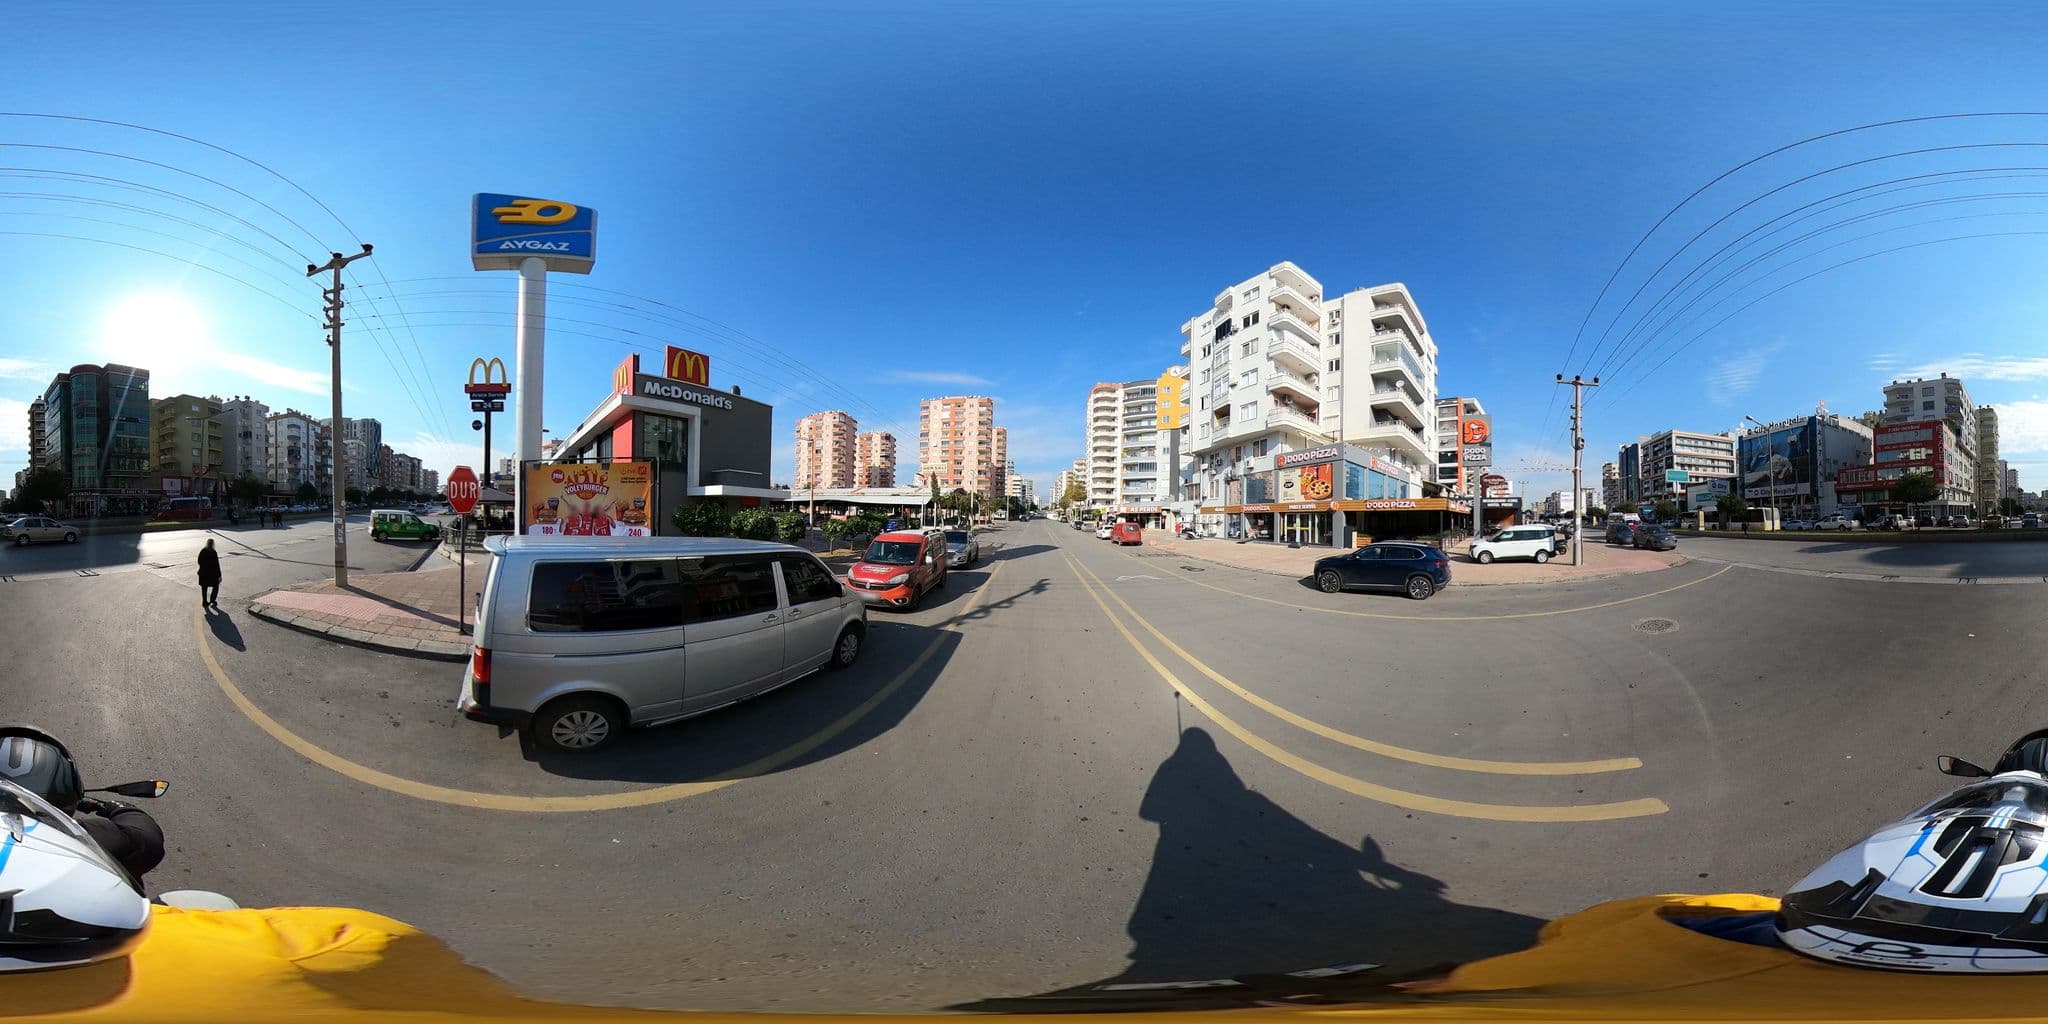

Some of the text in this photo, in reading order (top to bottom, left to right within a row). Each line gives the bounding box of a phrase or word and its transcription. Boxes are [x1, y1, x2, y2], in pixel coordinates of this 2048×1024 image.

[499, 240, 570, 251] AYGAZ
[644, 381, 733, 410] McDonald's
[1754, 425, 1767, 434] City
[1769, 415, 1799, 429] Hospital
[1287, 451, 1310, 463] DODO
[450, 481, 477, 499] DUR
[565, 483, 609, 496] VOLEYBURGER
[1366, 501, 1390, 509] DODO
[542, 526, 553, 535] 180
[629, 528, 642, 536] 240
